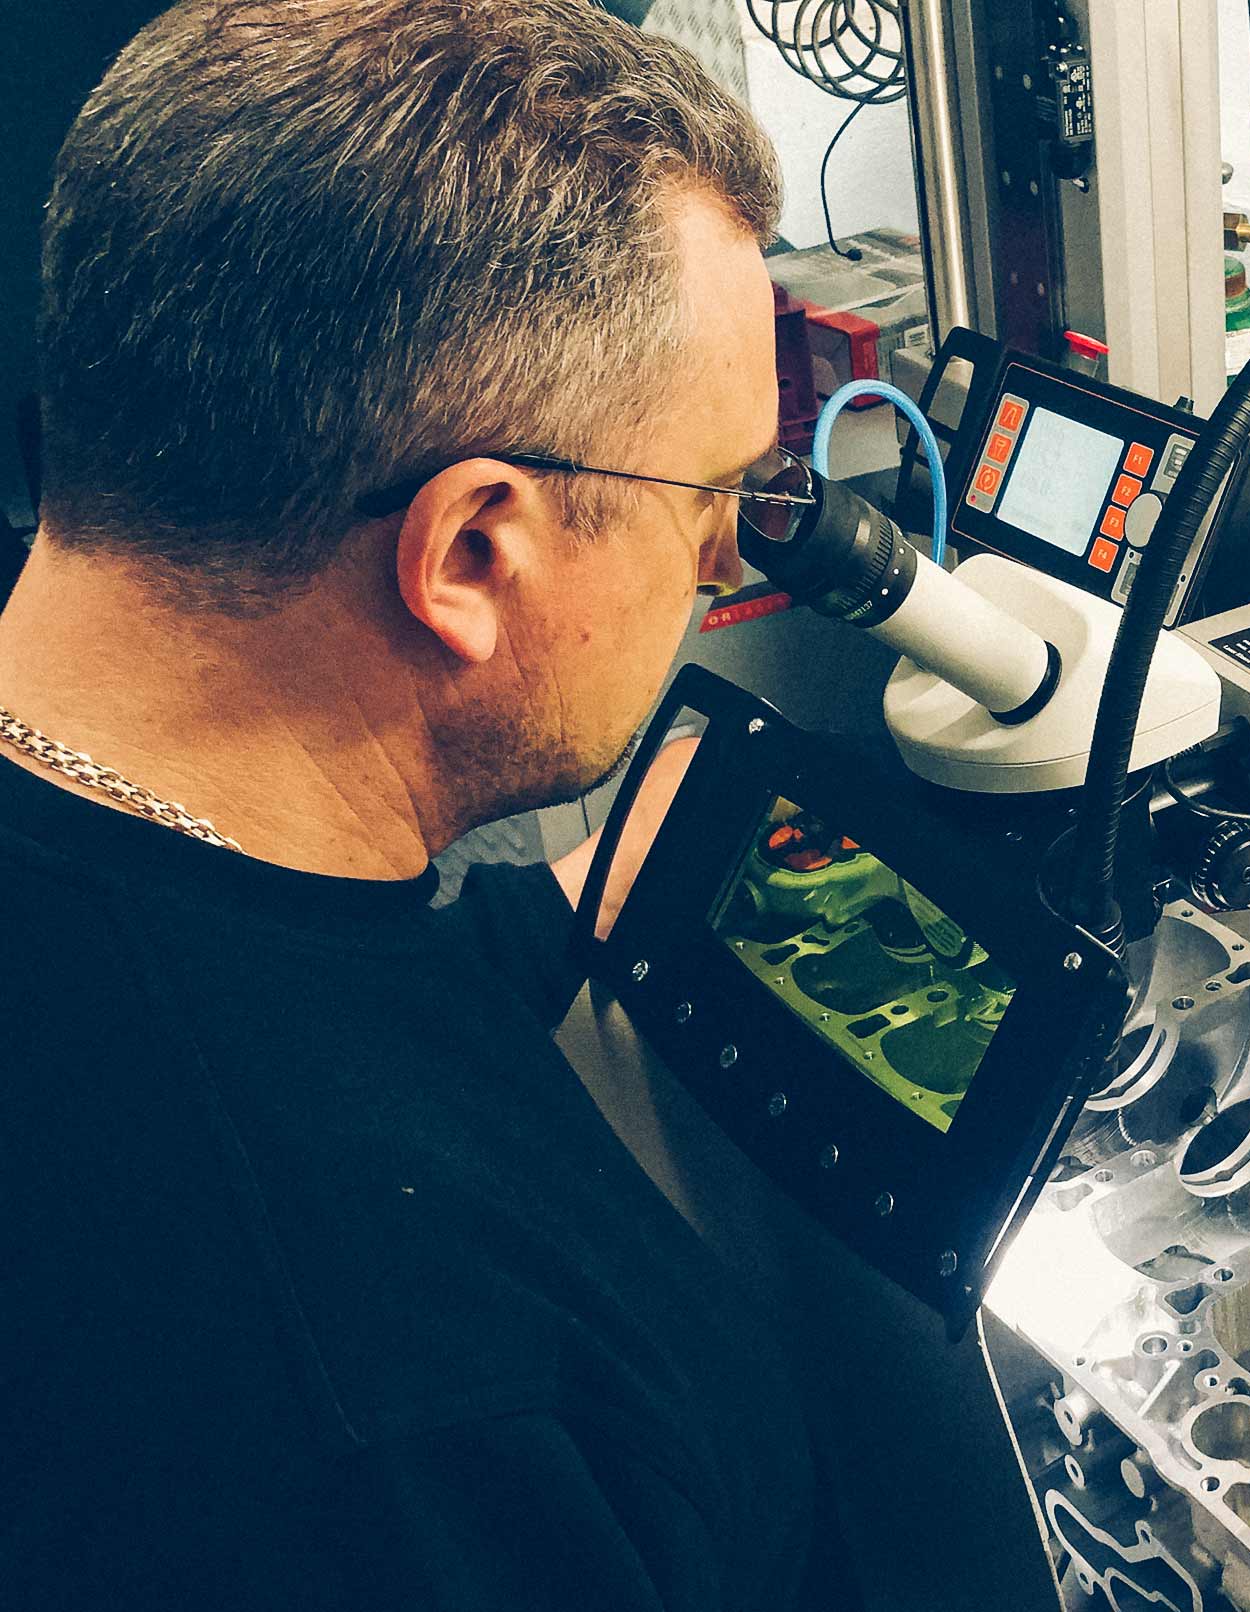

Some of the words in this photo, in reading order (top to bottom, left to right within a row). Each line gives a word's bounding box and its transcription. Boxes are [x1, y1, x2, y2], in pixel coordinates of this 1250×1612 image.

[1133, 454, 1142, 464] F1
[1121, 486, 1131, 497] F2
[1110, 517, 1120, 528] F3
[1097, 548, 1108, 559] F4
